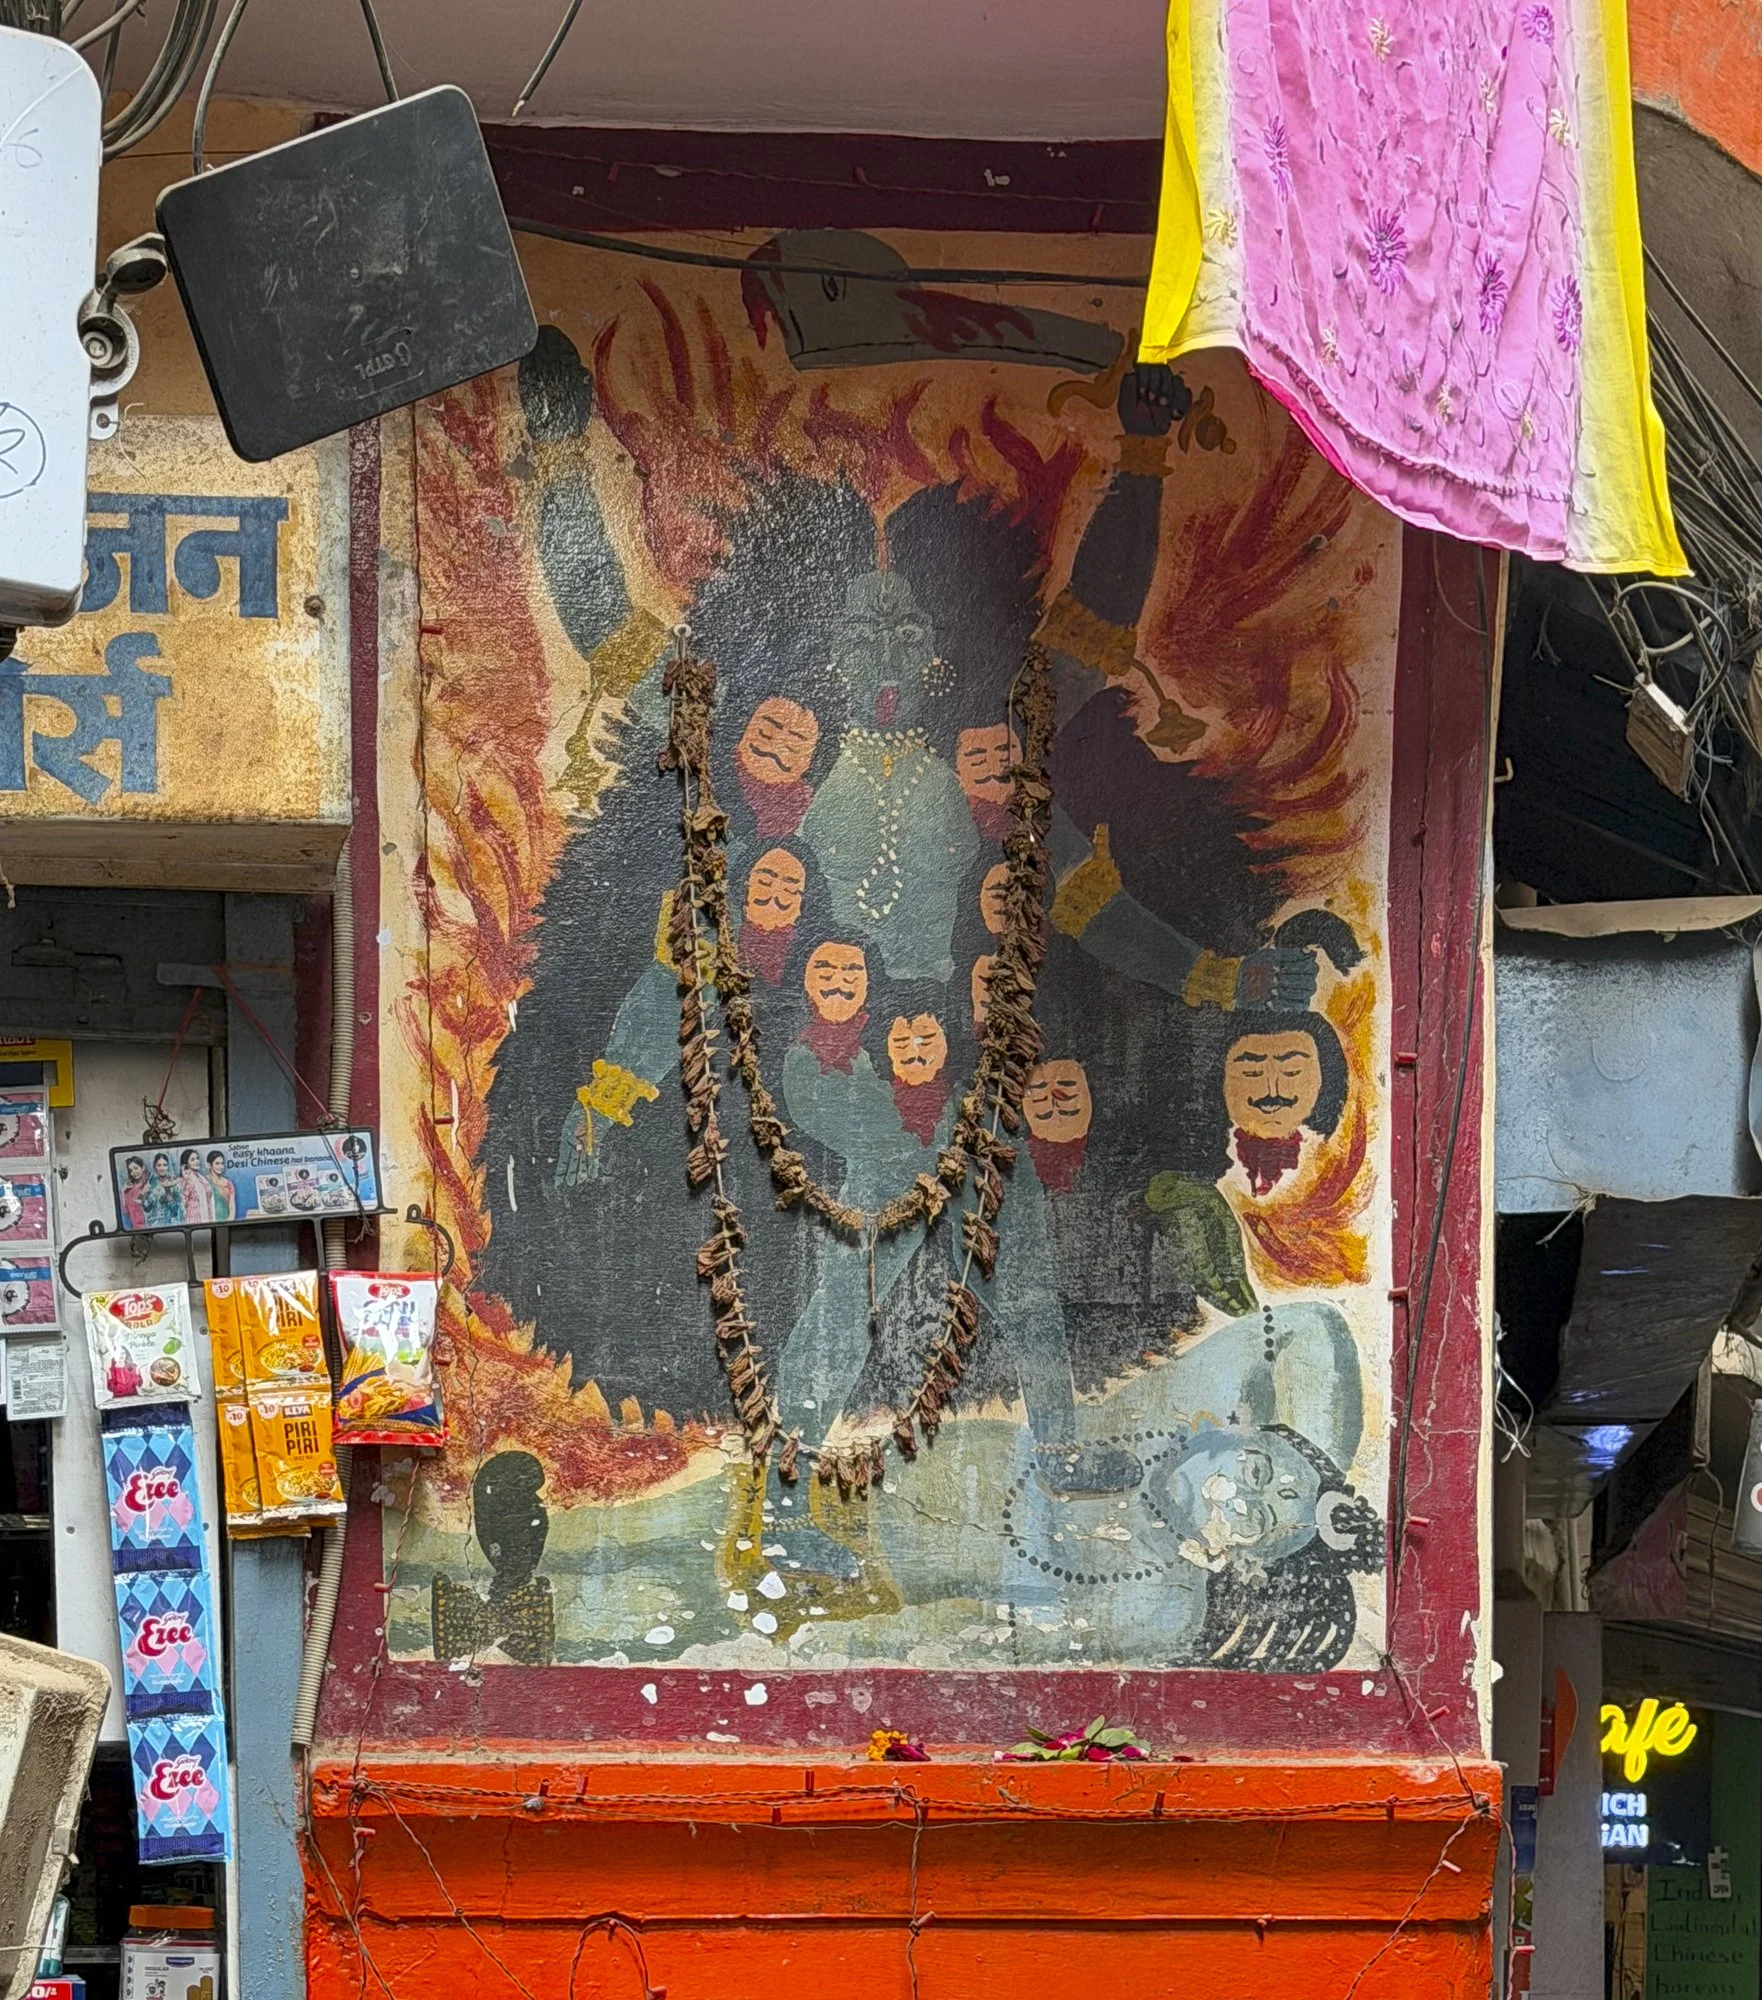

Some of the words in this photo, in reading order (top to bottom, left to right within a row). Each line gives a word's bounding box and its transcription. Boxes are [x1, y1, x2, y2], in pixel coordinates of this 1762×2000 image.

[226, 1159, 248, 1169] Desi
[251, 1156, 290, 1168] Chinese
[232, 1149, 255, 1159] easy
[118, 1296, 154, 1317] Tops
[284, 1420, 317, 1439] PIRI
[286, 1438, 319, 1455] PIRI
[124, 1473, 179, 1512] Ezee
[137, 1618, 191, 1657] Ezee
[150, 1761, 204, 1800] Ezee
